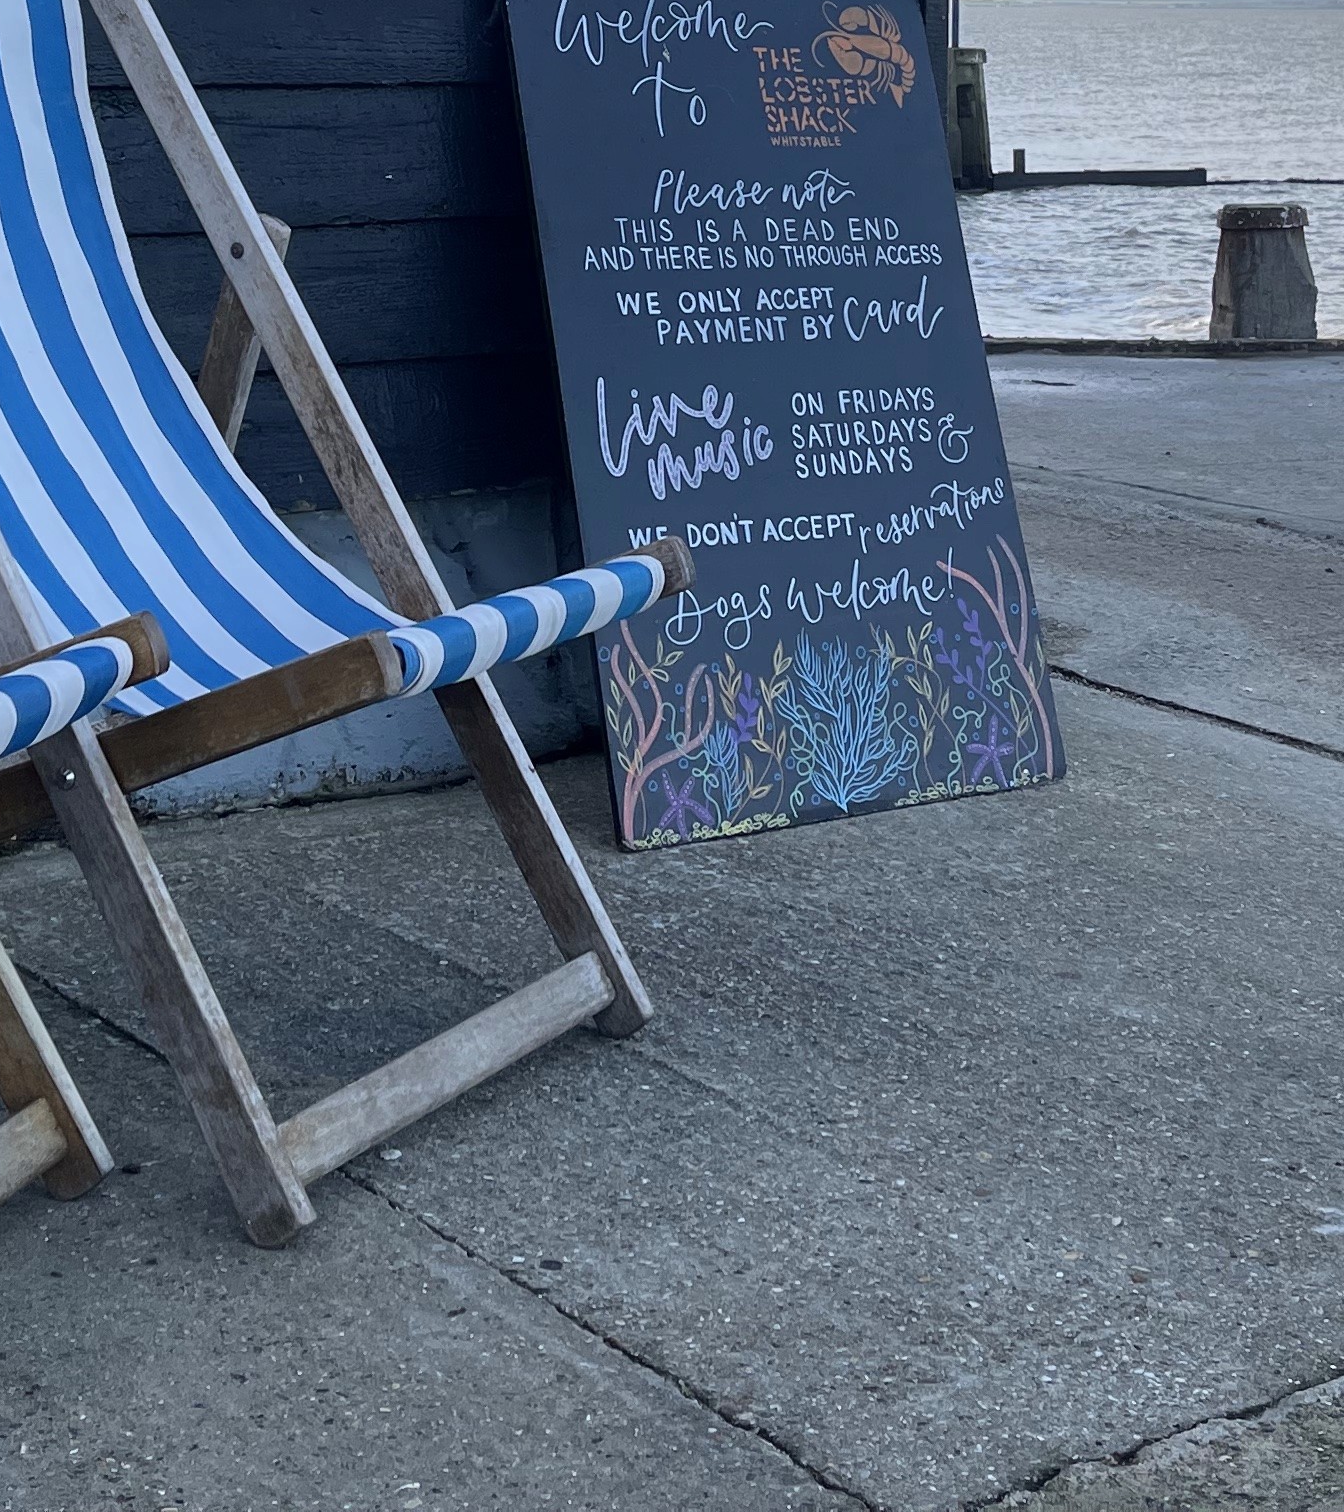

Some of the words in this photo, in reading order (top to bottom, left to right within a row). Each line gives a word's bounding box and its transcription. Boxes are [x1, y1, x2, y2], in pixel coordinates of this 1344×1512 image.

[752, 46, 805, 73] THE
[631, 60, 707, 138] to
[758, 76, 877, 105] LOBSTER
[764, 104, 858, 134] SHACK
[770, 135, 843, 148] WHITSTABLE
[653, 168, 774, 215] Please
[782, 167, 856, 213] note
[613, 217, 674, 244] THIS
[696, 218, 721, 244] IS
[732, 218, 748, 242] A
[765, 217, 835, 242] DEAD
[848, 217, 899, 242] END
[584, 245, 635, 271] AND
[639, 245, 714, 271] THERE
[717, 246, 738, 270] IS
[744, 244, 775, 269] NO
[778, 244, 868, 268] THROUGH
[874, 243, 943, 267] ACCESS
[616, 291, 662, 316] WE
[678, 287, 741, 314] ONLY
[756, 286, 834, 311] ACCEPT
[656, 316, 788, 346] PAYMENT
[802, 313, 835, 341] BY
[791, 392, 824, 417] ON
[838, 386, 935, 415] FRIDAYS
[596, 376, 734, 478] Live
[791, 417, 932, 450] SATURDAYS
[937, 412, 974, 464] &
[794, 445, 913, 479] SUNDAYS
[686, 512, 754, 548] DON'T
[762, 512, 856, 542] ACCEPT
[858, 477, 1004, 554] reservations
[664, 584, 772, 651] Dogs
